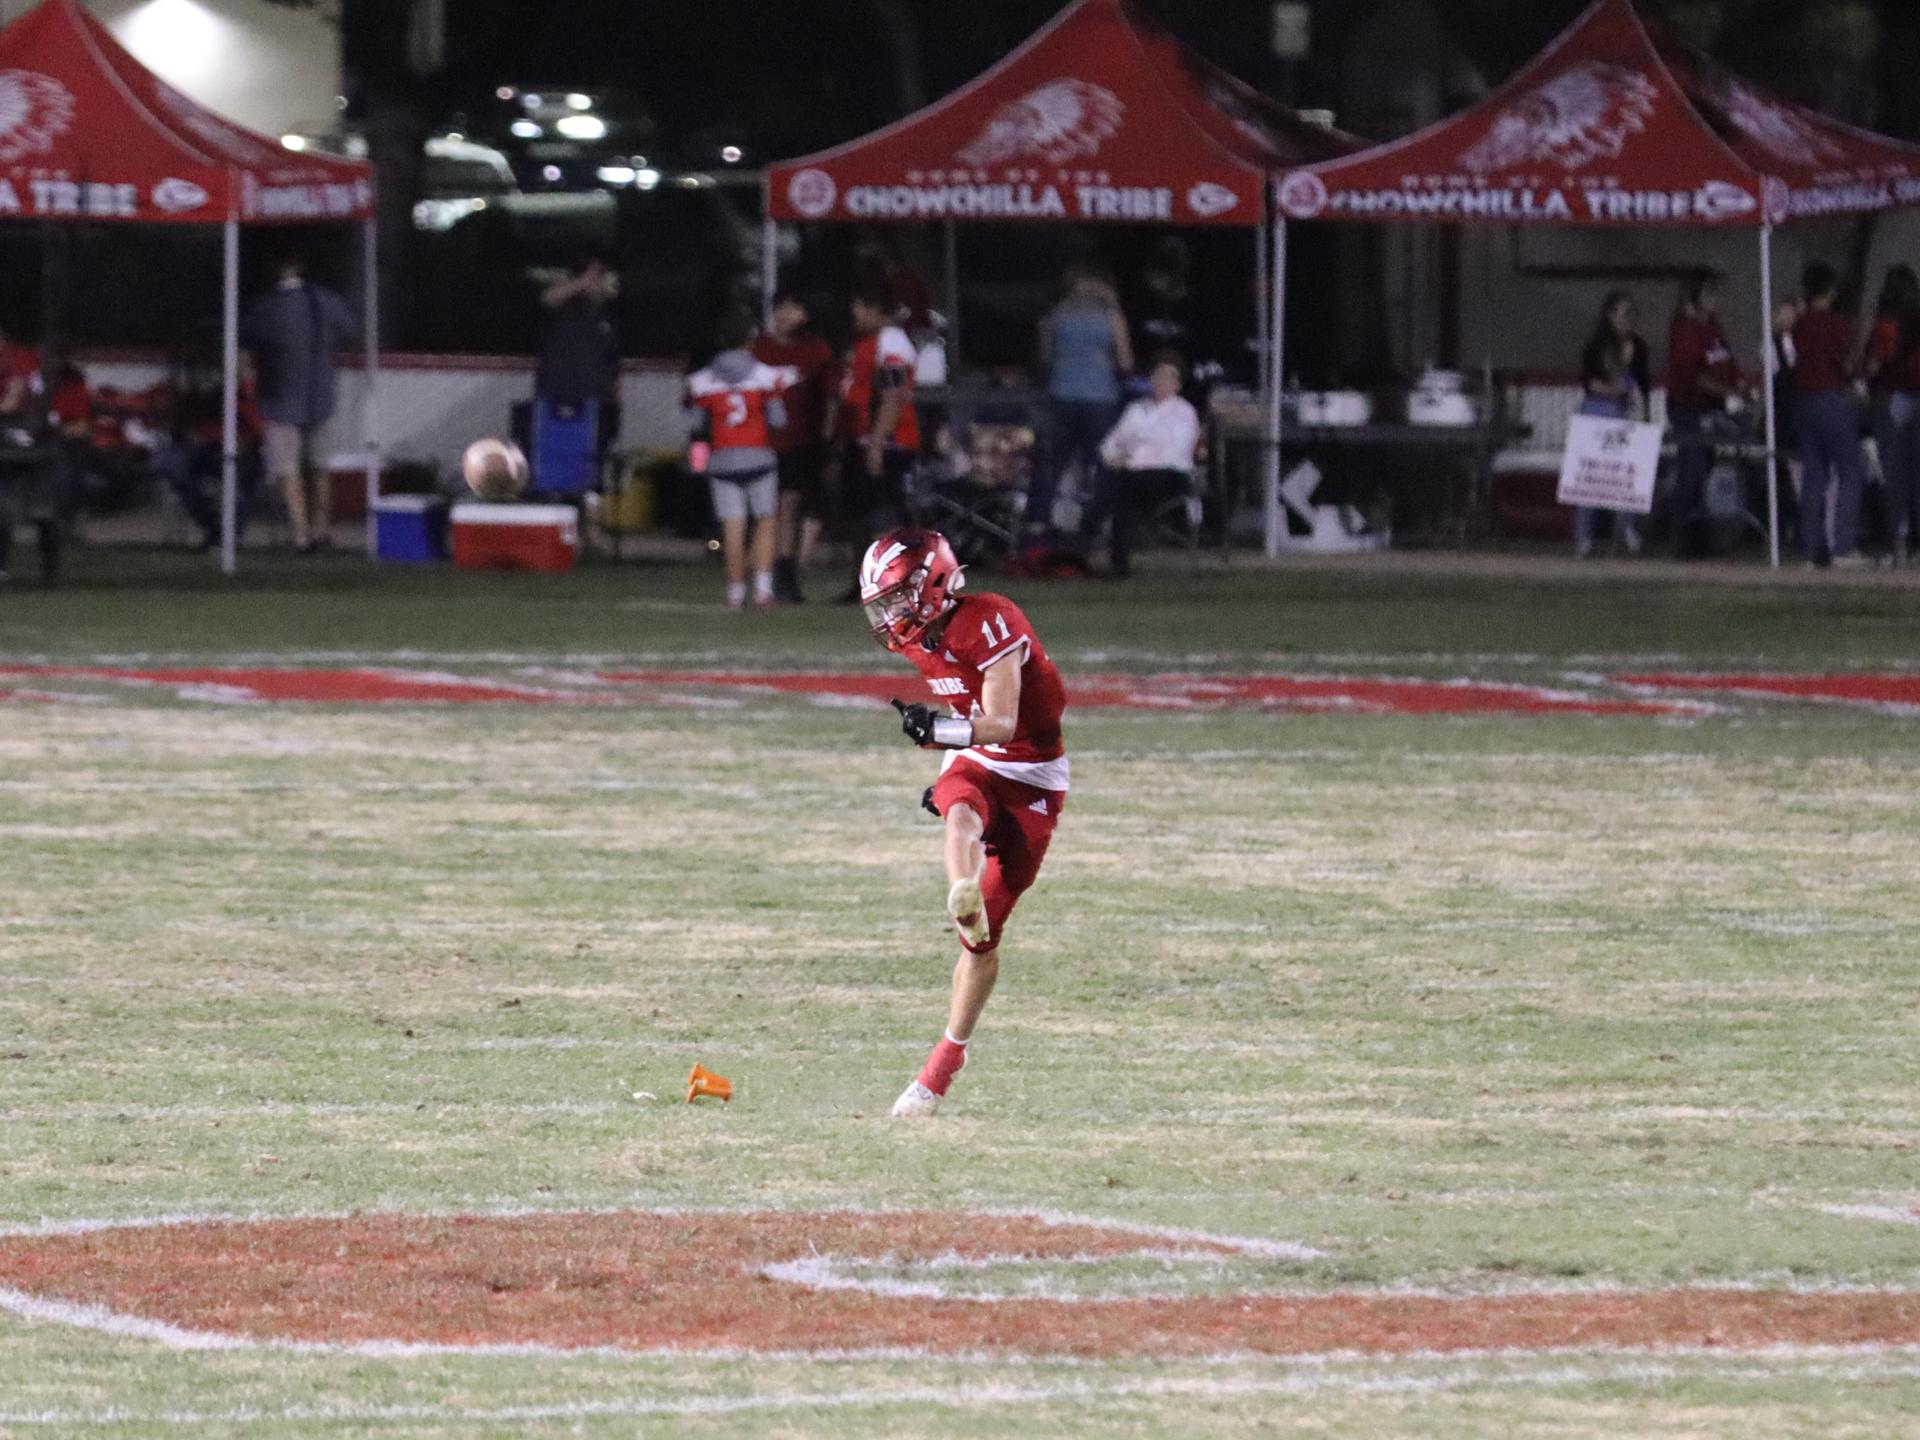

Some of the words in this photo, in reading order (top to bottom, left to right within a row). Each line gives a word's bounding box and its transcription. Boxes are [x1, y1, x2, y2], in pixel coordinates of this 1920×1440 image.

[845, 183, 1066, 217] CHOWCHILLA
[1075, 184, 1173, 219] TRIBE
[1330, 187, 1573, 220] CHOWCHILLA
[1584, 188, 1693, 220] TRIBE
[725, 392, 749, 427] 3
[981, 612, 1012, 648] 11
